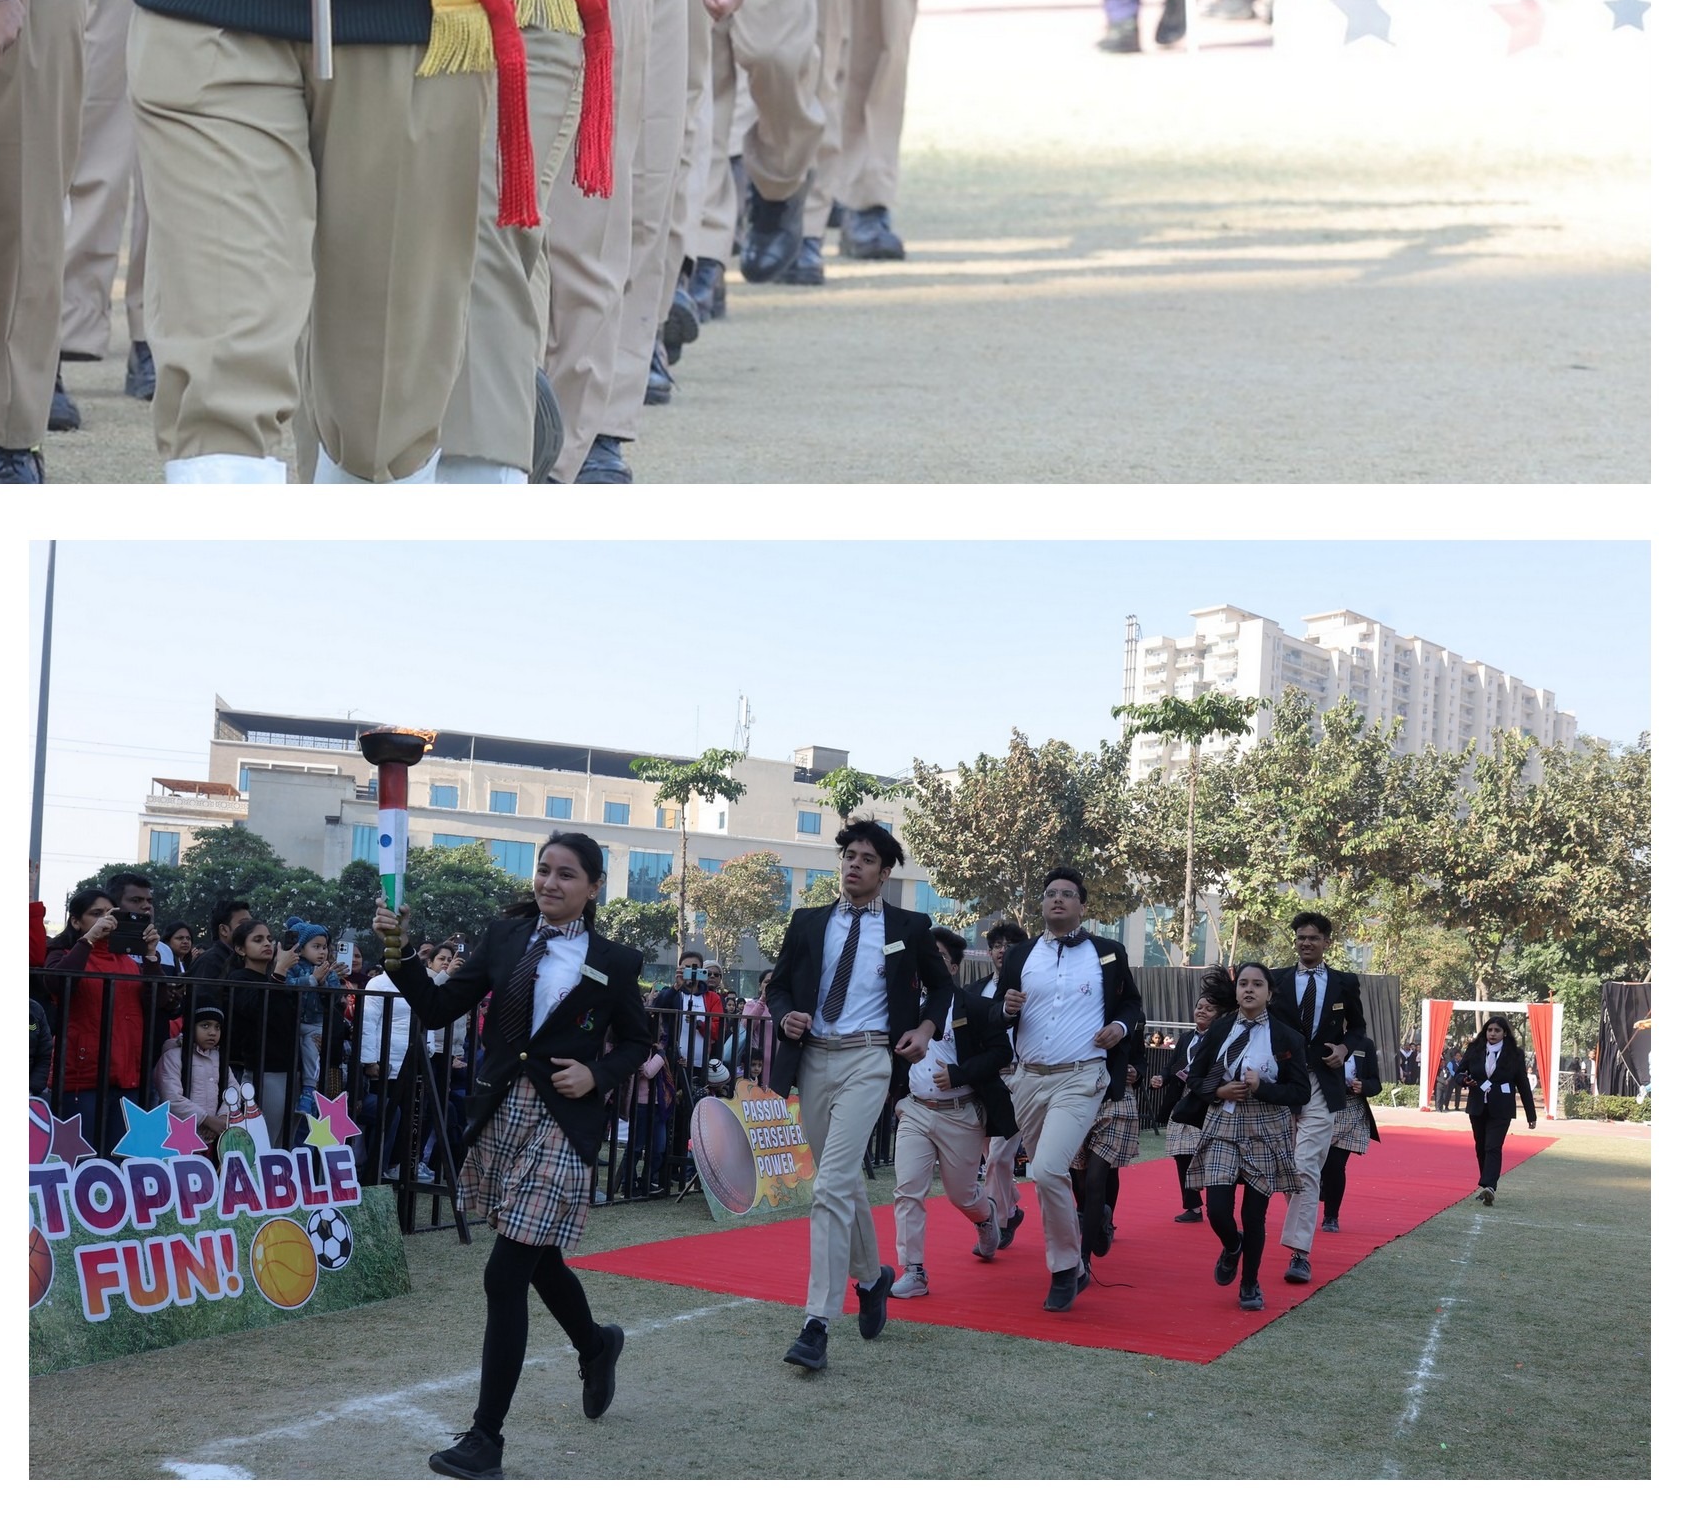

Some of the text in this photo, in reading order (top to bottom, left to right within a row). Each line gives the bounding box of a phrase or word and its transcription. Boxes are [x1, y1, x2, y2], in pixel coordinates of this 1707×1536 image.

[742, 1098, 793, 1124] PASSION,
[749, 1124, 807, 1151] PERSEVER
[756, 1151, 796, 1178] POWER
[80, 1233, 240, 1316] FUN!
